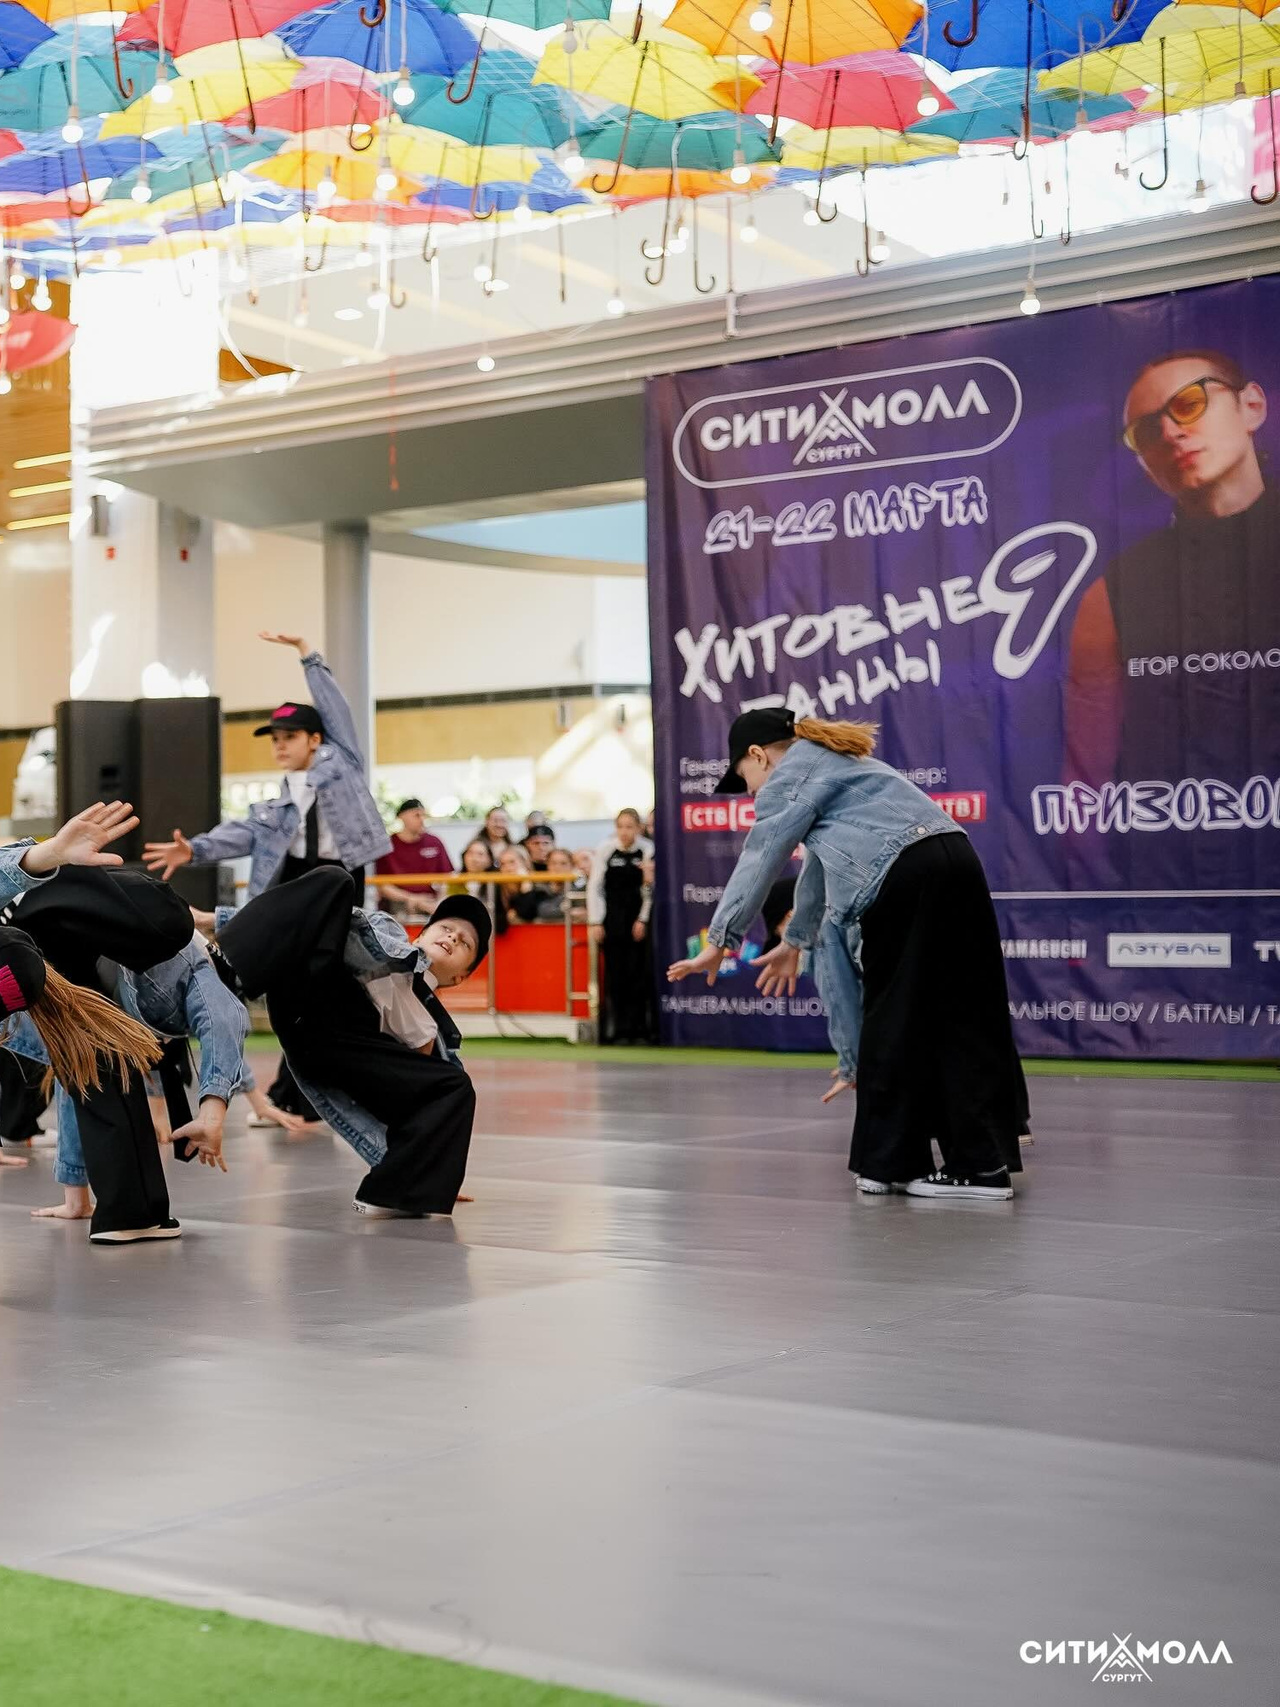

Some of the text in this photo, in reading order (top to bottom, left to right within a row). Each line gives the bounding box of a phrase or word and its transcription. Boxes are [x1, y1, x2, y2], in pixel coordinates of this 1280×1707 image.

[703, 475, 989, 555] 21-22 МАРТА
[674, 575, 983, 703] ХИТОВЫЕ
[1128, 648, 1280, 677] ЕГОР СОКОЛО
[1090, 1001, 1143, 1023] ШОУ
[1163, 1003, 1244, 1025] БАТТЛЫ
